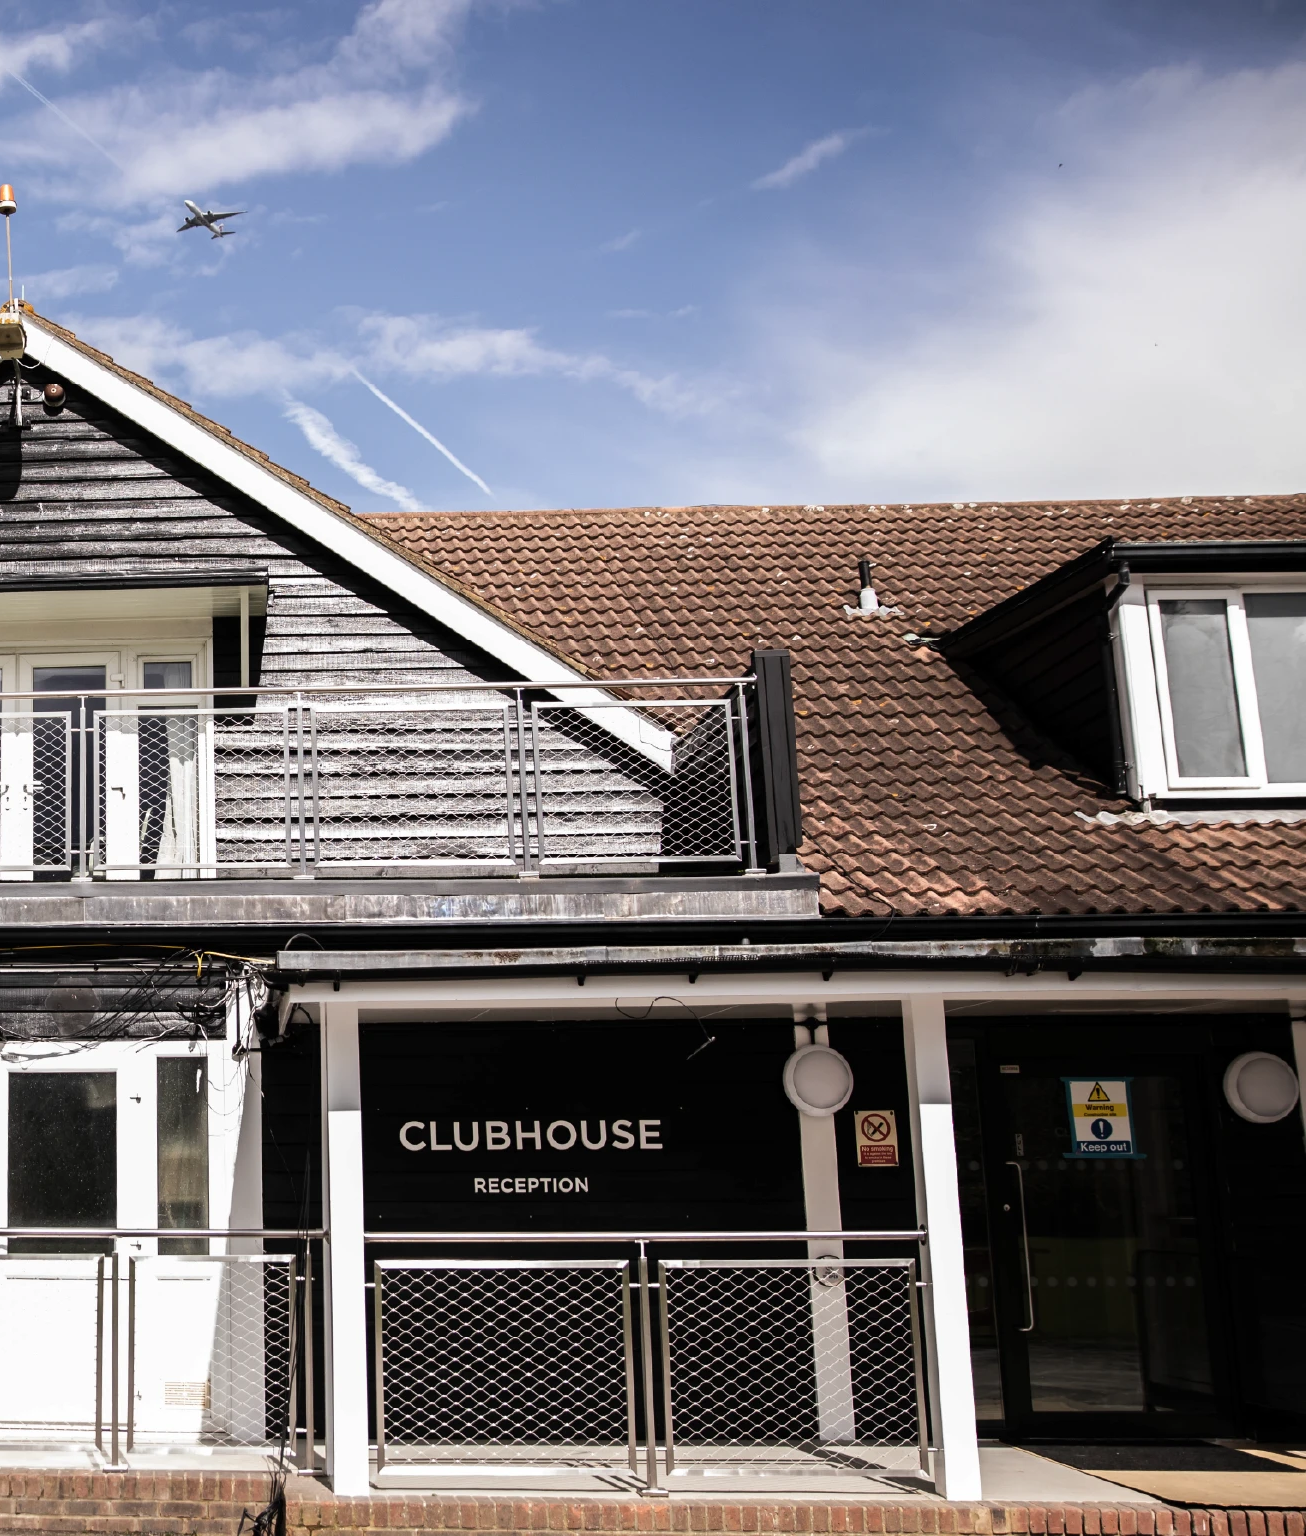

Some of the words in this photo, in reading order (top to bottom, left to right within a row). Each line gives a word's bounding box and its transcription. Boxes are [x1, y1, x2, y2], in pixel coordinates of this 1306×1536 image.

[1085, 1104, 1114, 1112] Warning
[399, 1119, 663, 1151] CLUBHOUSE
[1080, 1142, 1107, 1152] Keep
[1109, 1142, 1127, 1151] out
[474, 1177, 589, 1193] RECEPTION
